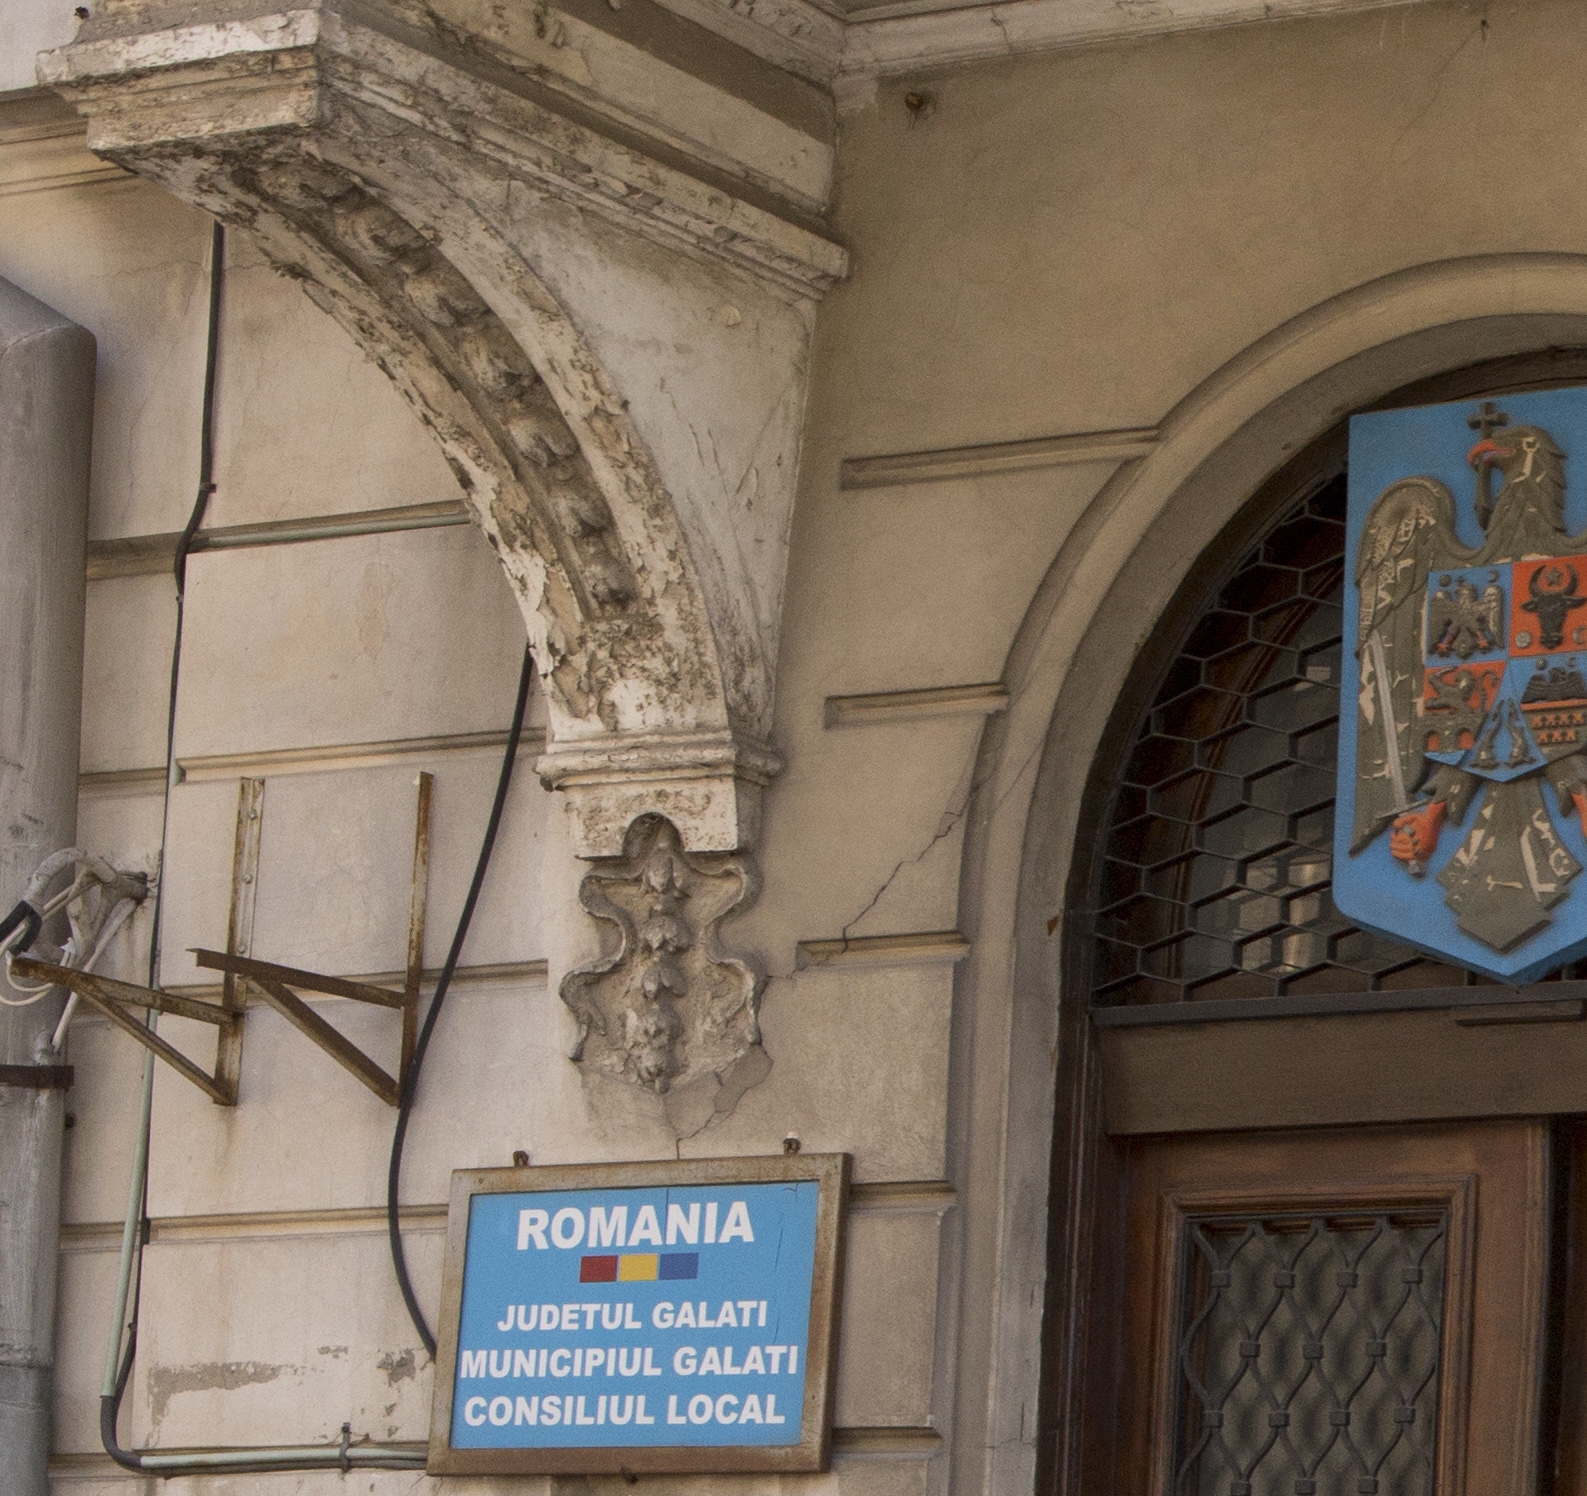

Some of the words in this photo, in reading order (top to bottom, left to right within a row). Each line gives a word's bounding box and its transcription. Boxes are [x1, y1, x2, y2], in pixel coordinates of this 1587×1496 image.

[516, 1201, 755, 1250] ROMANIA
[498, 1302, 642, 1332] JUDETUL
[652, 1300, 768, 1329] GALATI
[460, 1347, 662, 1379] MUNICIPIUL
[673, 1345, 799, 1376] GALATI
[464, 1395, 655, 1427] CONSILIUL
[667, 1394, 786, 1425] LOCAL
